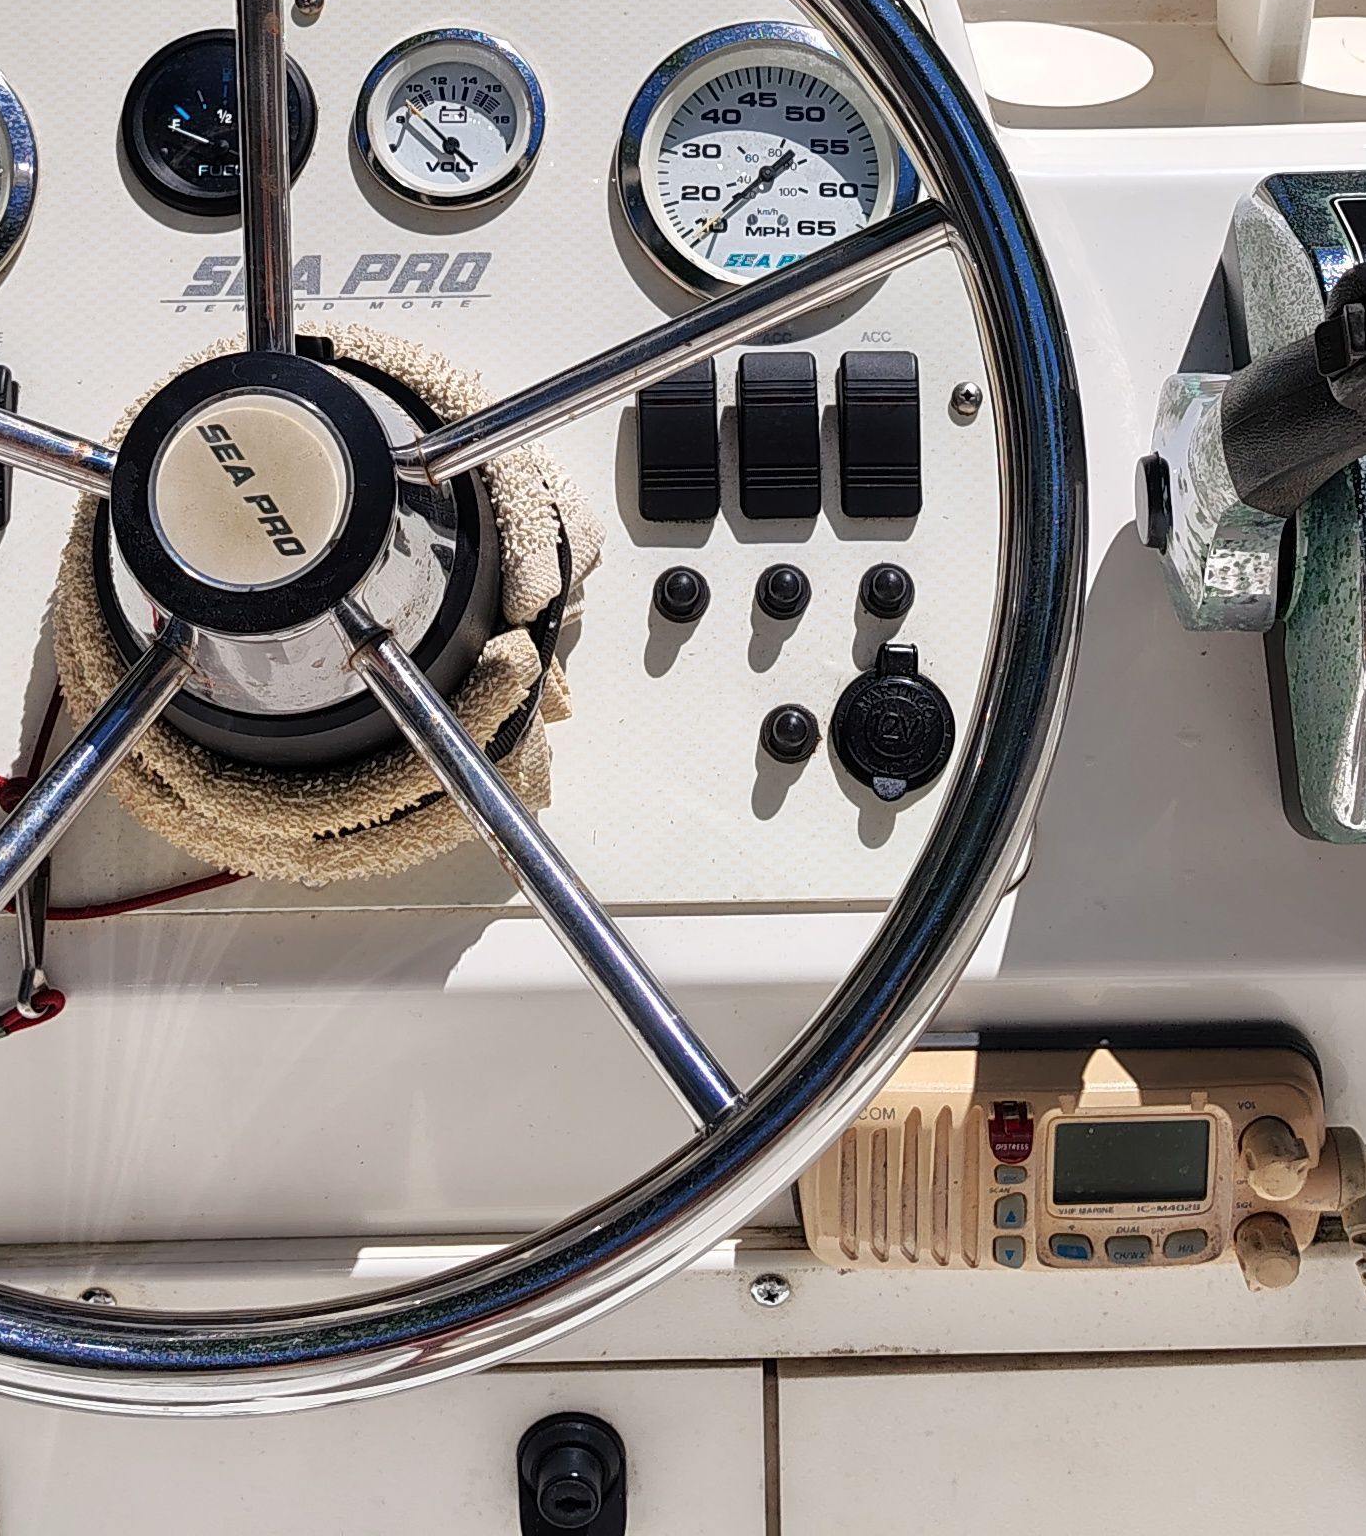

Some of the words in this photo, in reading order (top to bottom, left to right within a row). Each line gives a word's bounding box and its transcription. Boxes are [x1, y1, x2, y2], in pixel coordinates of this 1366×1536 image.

[430, 77, 448, 85] 12
[460, 77, 478, 85] 14
[406, 85, 423, 93] 10
[737, 92, 778, 108] 45
[700, 108, 741, 124] 40
[785, 106, 826, 122] 50
[681, 143, 722, 159] 30
[768, 148, 782, 157] 80
[809, 139, 850, 155] 55
[745, 154, 759, 163] 60
[426, 161, 479, 173] VOLT
[681, 185, 721, 201] 20
[779, 187, 797, 197] 100
[818, 183, 859, 198] 60
[757, 207, 778, 216] km/h
[745, 226, 790, 238] MPH
[797, 220, 836, 236] 65
[723, 253, 771, 268] SEA
[182, 254, 322, 296] SA
[339, 252, 492, 295] PRO
[174, 302, 335, 313] DEMND
[369, 300, 471, 310] MORE
[762, 332, 793, 344] ACC
[860, 331, 892, 344] ACC
[197, 423, 256, 487] SEA
[243, 494, 307, 557] PRO
[858, 1107, 896, 1121] COM
[995, 1143, 1030, 1151] DISTRESS
[1116, 1225, 1140, 1234] DUAL
